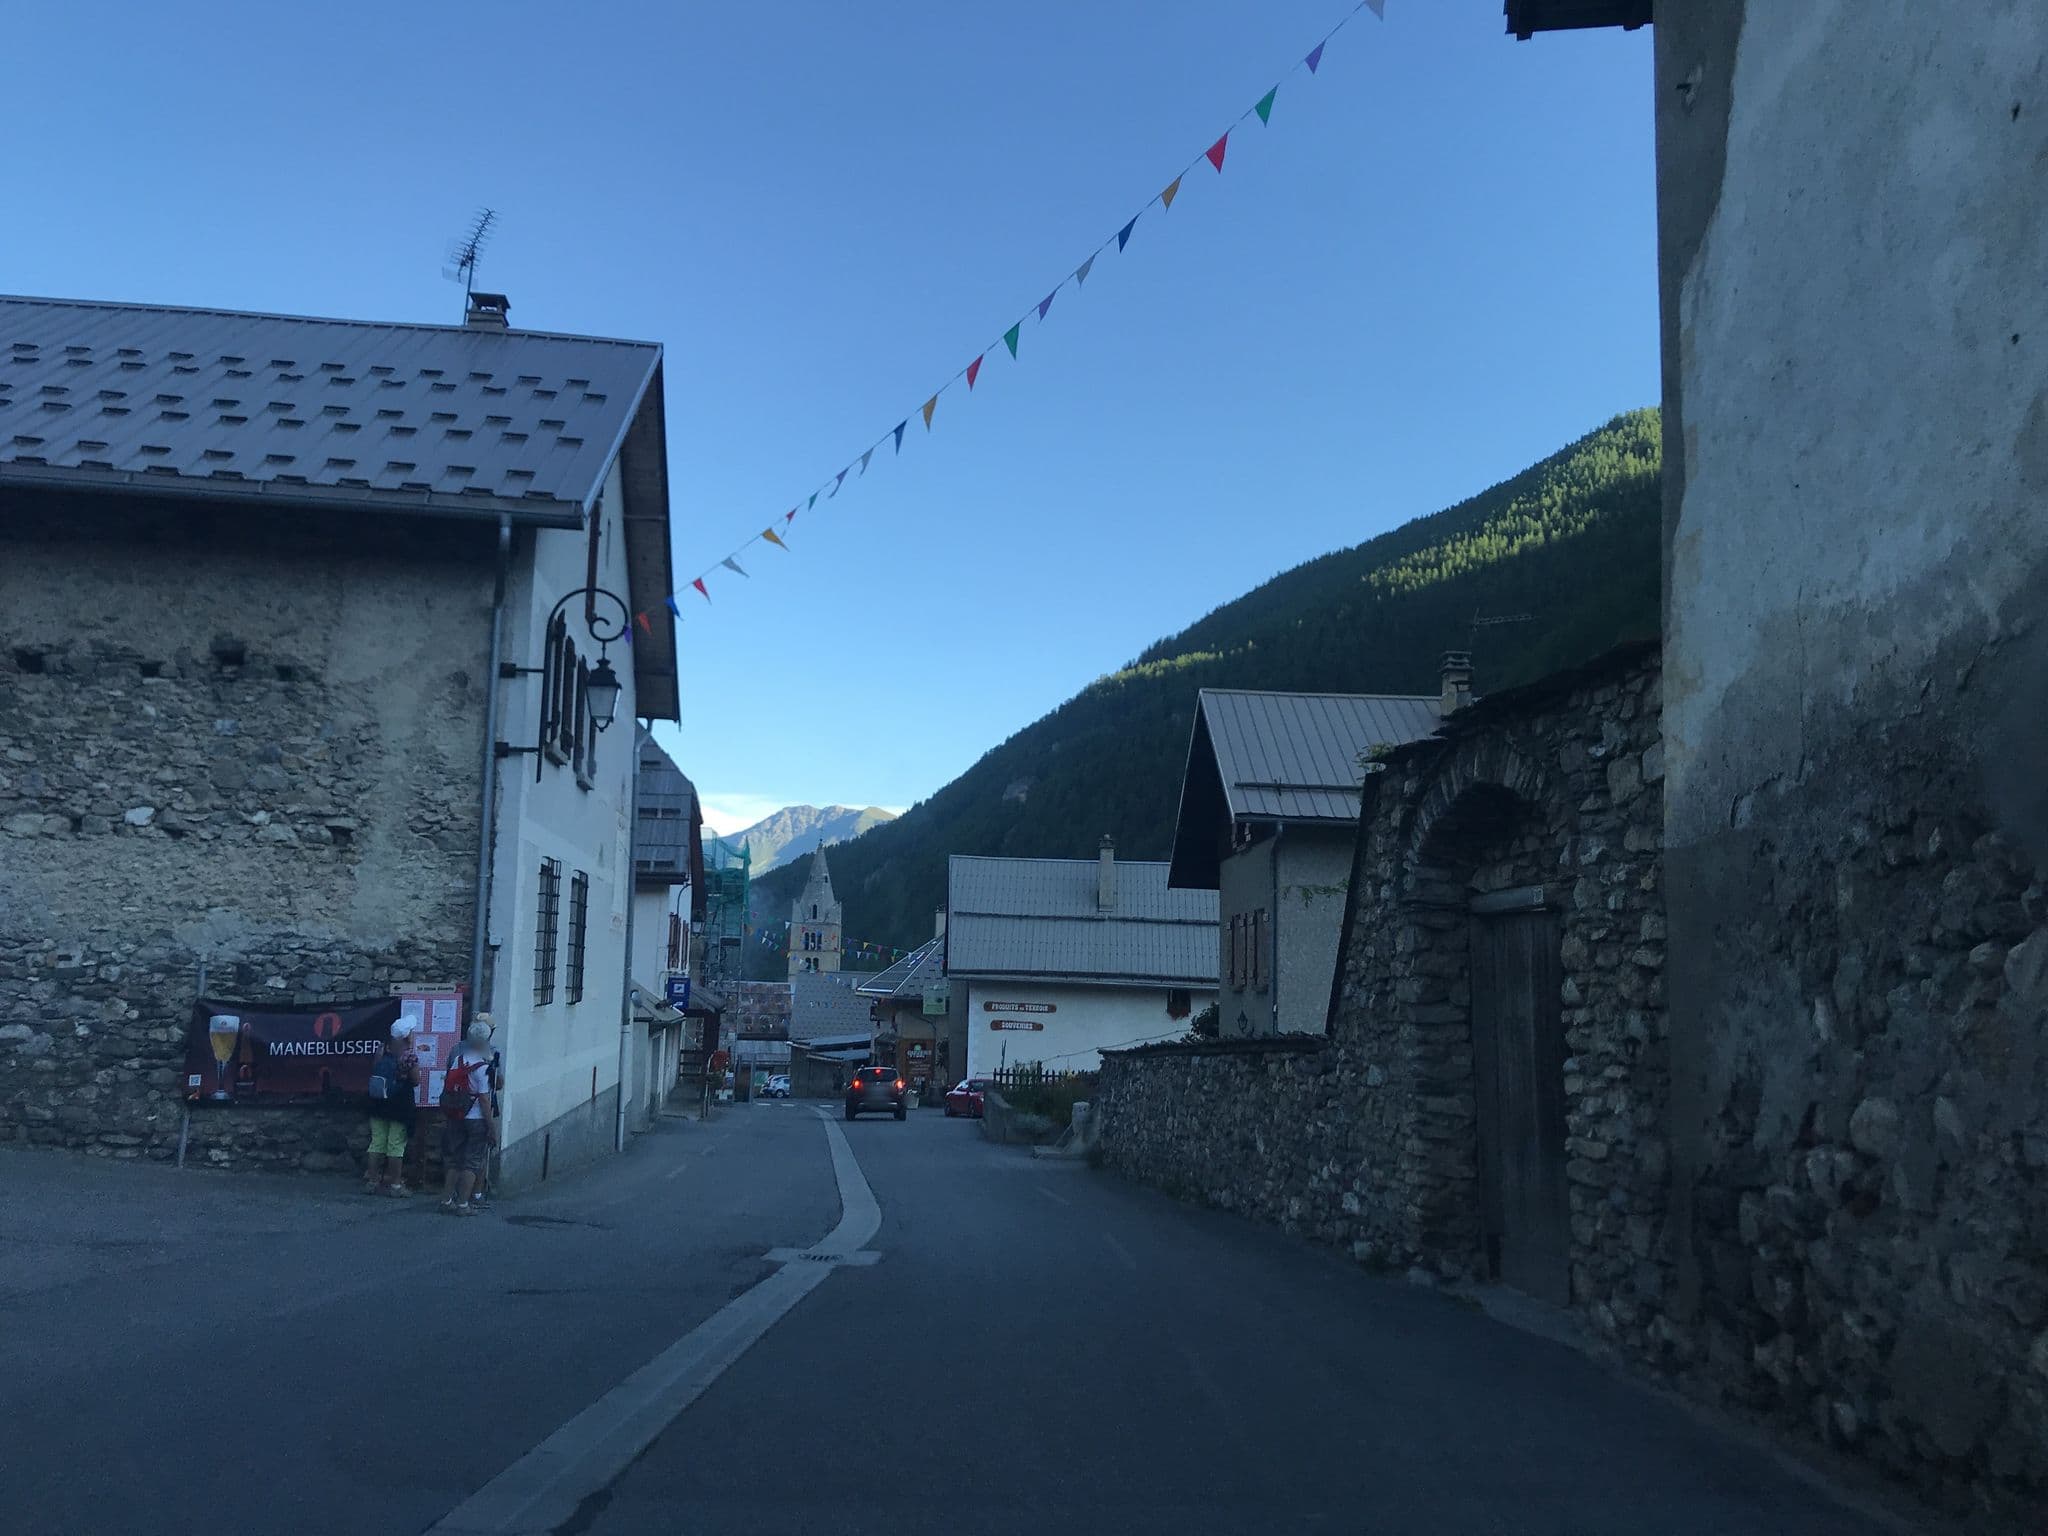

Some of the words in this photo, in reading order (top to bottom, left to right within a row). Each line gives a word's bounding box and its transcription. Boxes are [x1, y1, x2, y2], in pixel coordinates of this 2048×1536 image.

[991, 1003, 1019, 1011] PRODUITS
[1025, 1004, 1049, 1012] TERROIR
[1001, 1021, 1033, 1030] SOUVENIRS
